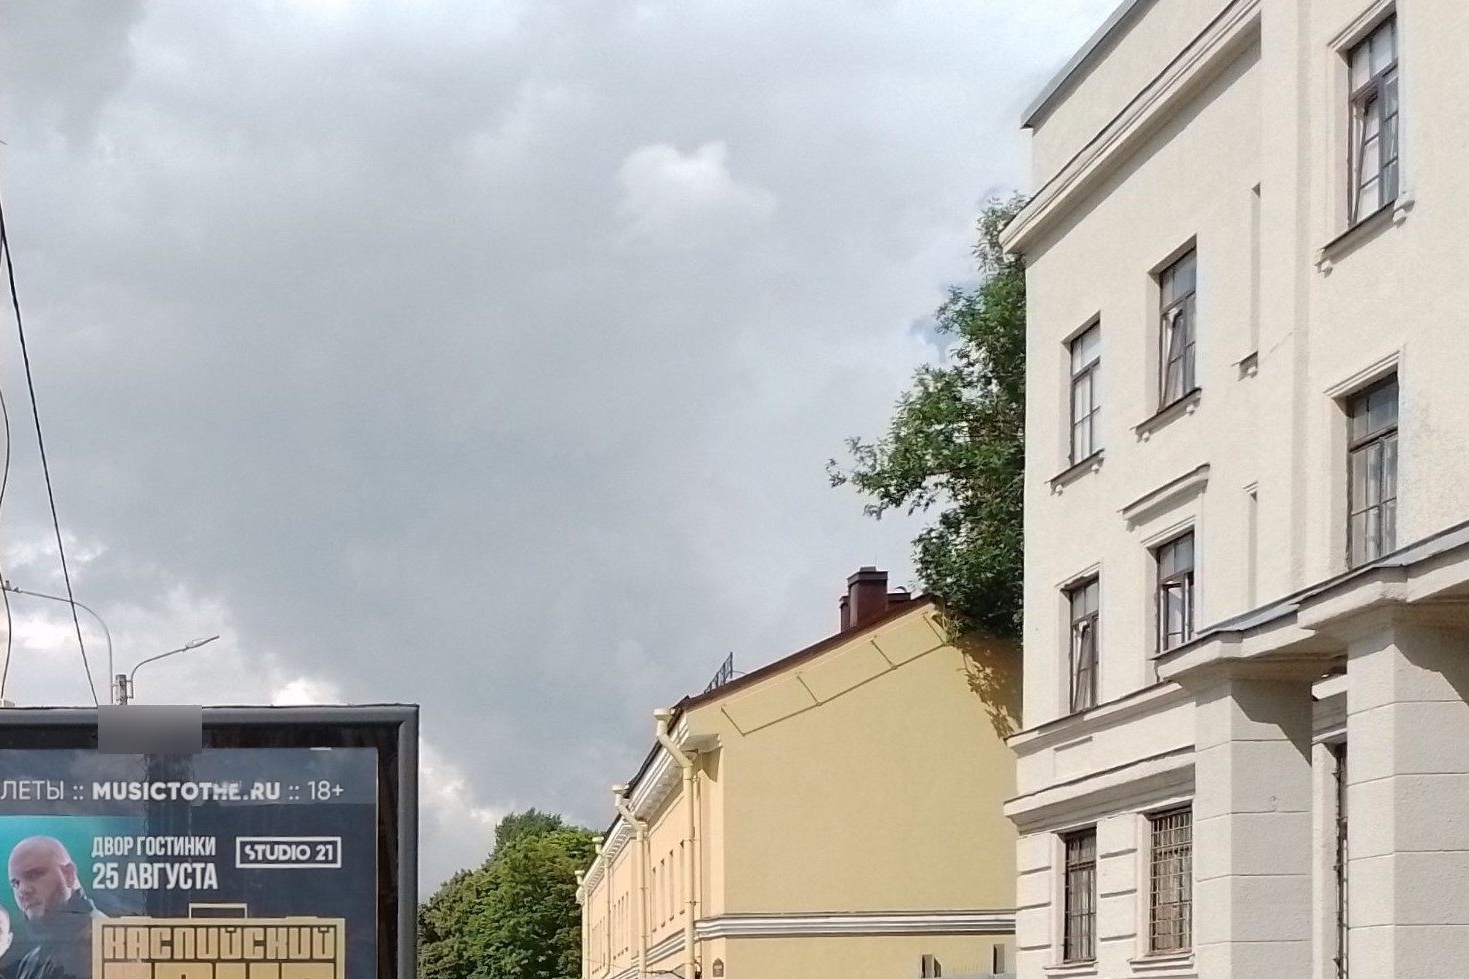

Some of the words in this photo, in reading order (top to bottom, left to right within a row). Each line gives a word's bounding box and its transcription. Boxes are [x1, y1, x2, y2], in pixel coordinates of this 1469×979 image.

[92, 781, 281, 801] MUSICTOTHE.RU
[307, 780, 345, 801] 18+
[91, 836, 134, 858] ДВОР
[136, 836, 216, 856] ГОСТИНКИ
[243, 844, 311, 861] STUDIO
[314, 844, 334, 861] 21
[92, 861, 119, 890] 25
[123, 861, 219, 891] АВГУСТА
[102, 926, 336, 960] КАСПИЙСКИЙ
